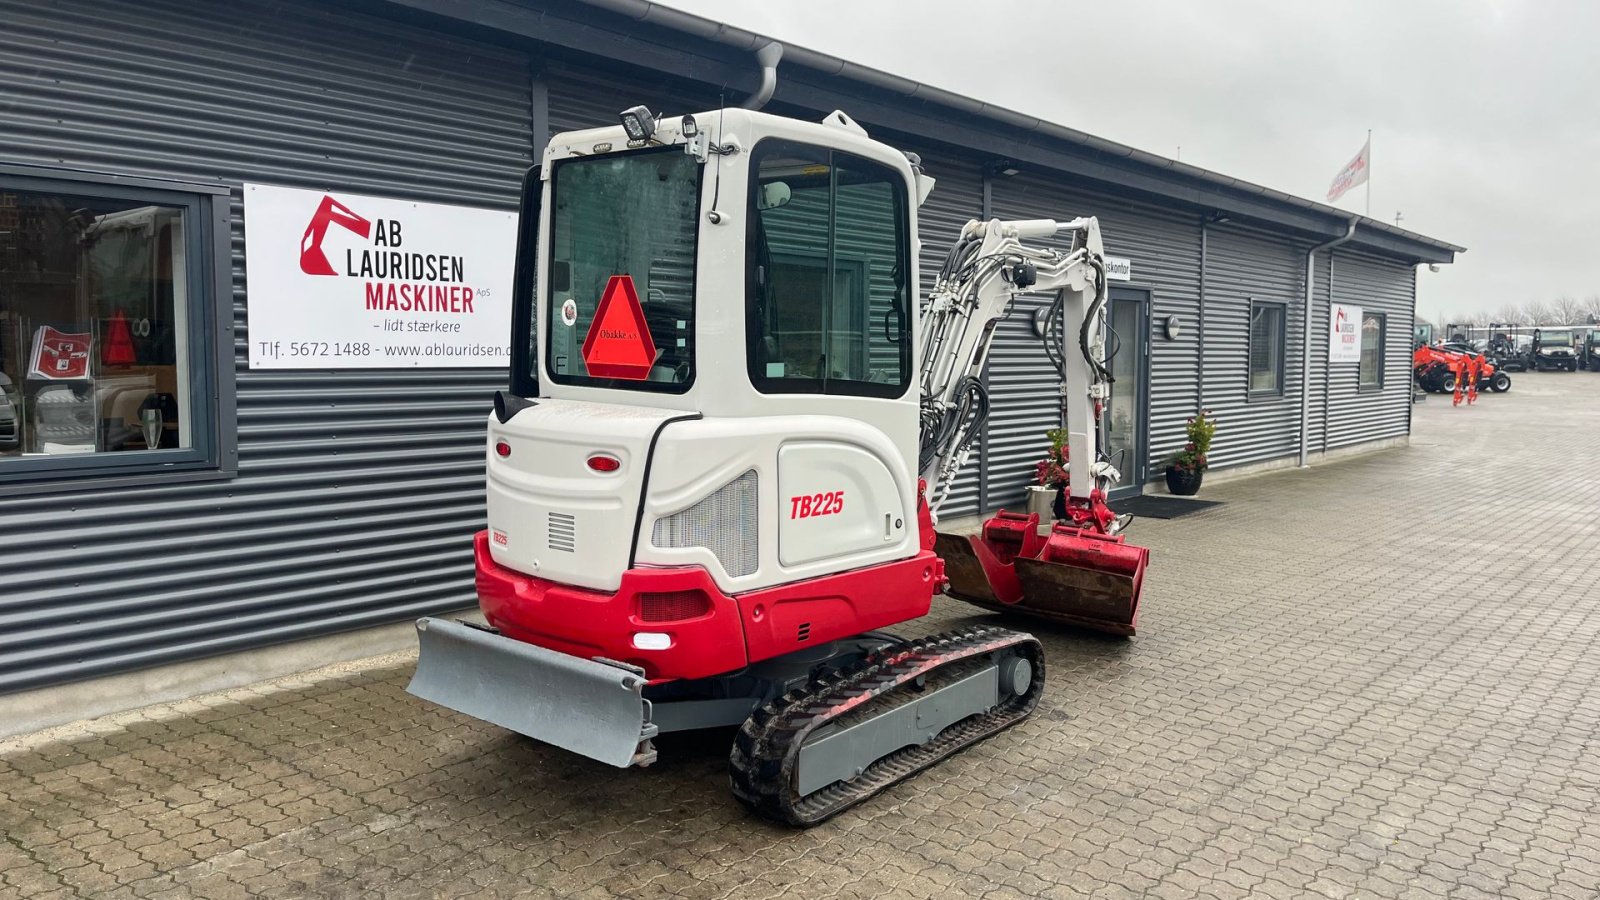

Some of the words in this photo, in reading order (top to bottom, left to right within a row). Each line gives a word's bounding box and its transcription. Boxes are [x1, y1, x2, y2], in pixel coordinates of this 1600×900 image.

[374, 219, 402, 247] AB
[346, 248, 464, 283] LAURIDSEN
[365, 281, 474, 314] MASKINER
[476, 288, 491, 297] ApS
[384, 319, 404, 332] lidt
[407, 320, 461, 333] stærkere
[259, 341, 285, 360] Tlf.
[290, 342, 329, 357] 5672
[333, 342, 371, 357] 1488
[791, 491, 845, 519] TB225
[493, 531, 508, 546] TB225
